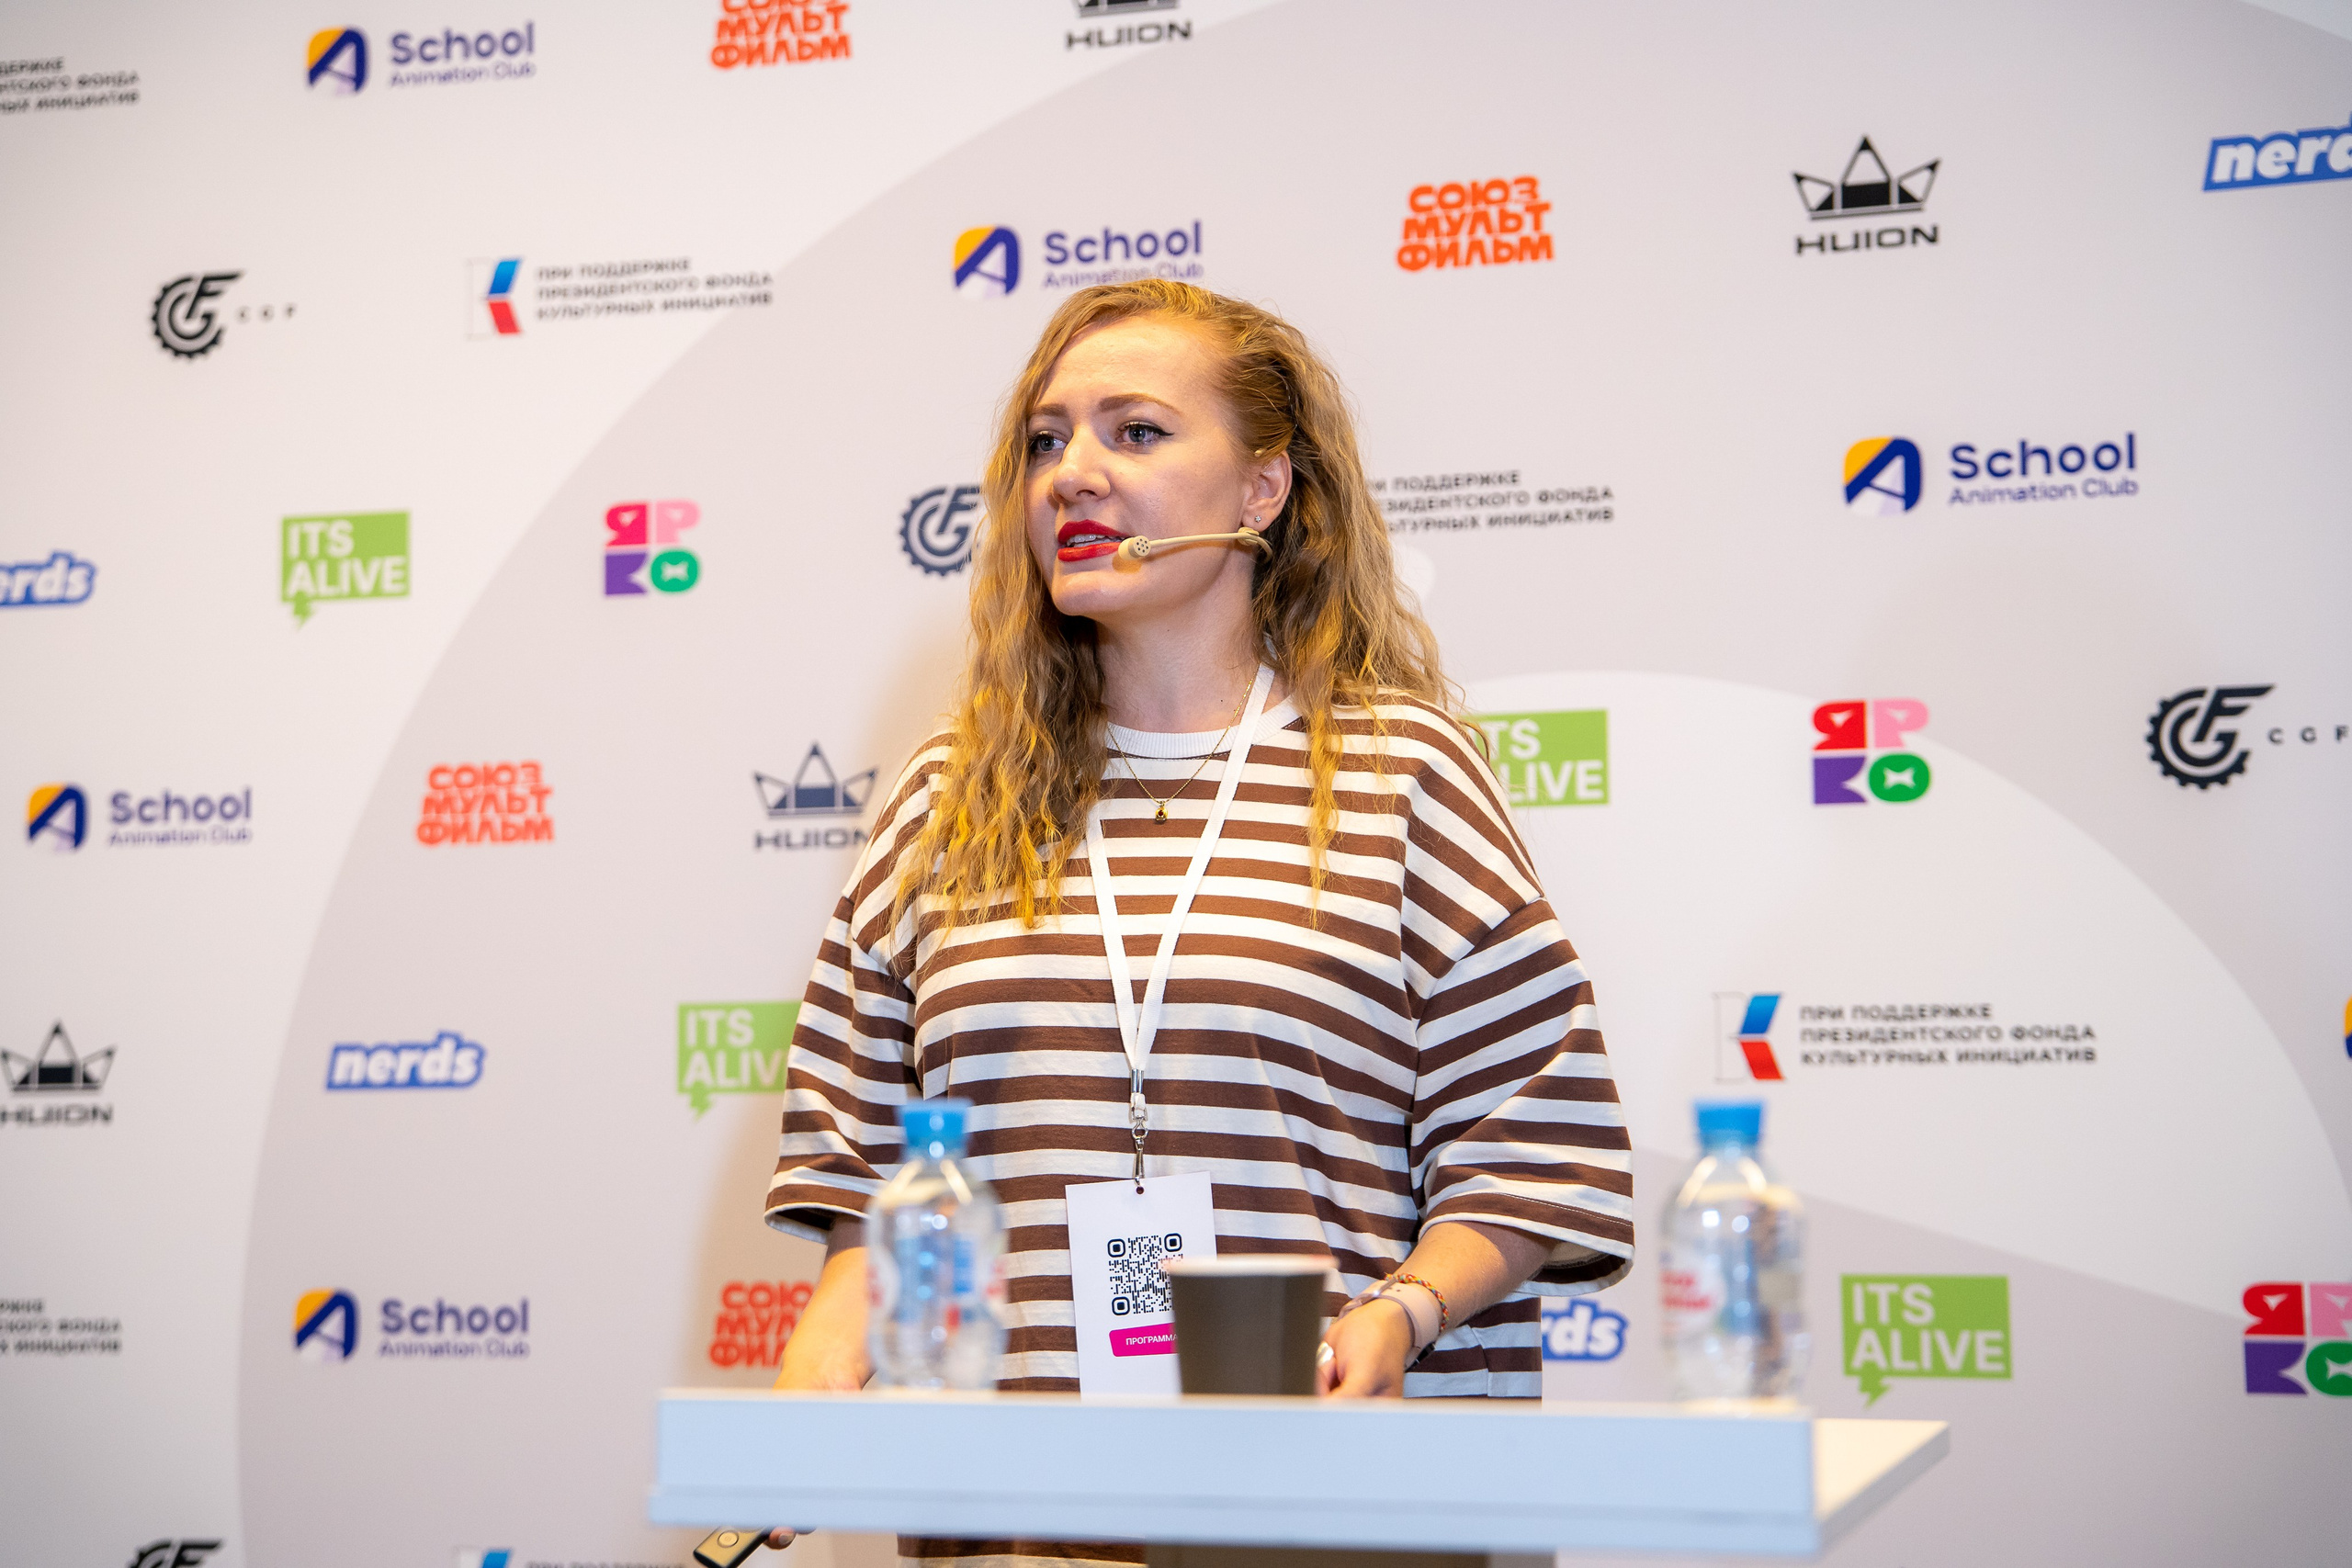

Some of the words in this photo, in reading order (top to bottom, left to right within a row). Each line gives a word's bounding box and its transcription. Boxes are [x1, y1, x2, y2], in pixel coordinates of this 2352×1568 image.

[716, 5, 850, 38] МУЛЬТ
[1066, 20, 1193, 50] HUION
[390, 18, 535, 64] School
[710, 35, 853, 70] ФИЛЬМ
[390, 66, 489, 87] Animation
[495, 61, 537, 80] Club
[2211, 132, 2352, 184] ner
[1409, 175, 1539, 213] СОЮЗ
[1403, 202, 1551, 240] МУЛЬТ
[1796, 225, 1939, 255] HUION
[1045, 220, 1203, 265] School
[1396, 234, 1554, 272] ФИЛЬМ
[1951, 432, 2137, 479] School
[1393, 469, 1521, 492] ПОДДЕРЖКЕ
[1537, 486, 1614, 505] ФОНДА
[1949, 482, 2077, 505] Animation
[2082, 477, 2139, 499] Club
[288, 519, 355, 559] ITS
[0, 557, 88, 603] rds
[287, 556, 407, 597] ALIVE
[428, 761, 541, 790] СОЮЗ
[1499, 759, 1604, 803] LIVE
[110, 786, 253, 824] School
[423, 785, 553, 815] МУЛЬТ
[417, 818, 555, 845] ФИЛЬМ
[685, 1009, 754, 1048] ITS
[1800, 1004, 1844, 1021] ПРИ
[1851, 1002, 1993, 1021] ПОДДЕРЖКЕ
[1800, 1026, 2004, 1045] ПРЕЗИДЕНТСКОГО
[2009, 1024, 2097, 1043] ФОНДА
[334, 1037, 481, 1085] nerds
[684, 1049, 784, 1088] ALIV
[1801, 1049, 1950, 1066] КУЛЬТУРНЫХ
[1956, 1046, 2098, 1067] ИНИЦИАТИВ
[721, 1280, 815, 1309] СОЮ
[1852, 1282, 1936, 1325] ITS
[380, 1297, 529, 1335] School
[716, 1312, 797, 1337] МУЛ
[379, 1340, 481, 1358] Animation
[1851, 1328, 2006, 1372] ALIVE
